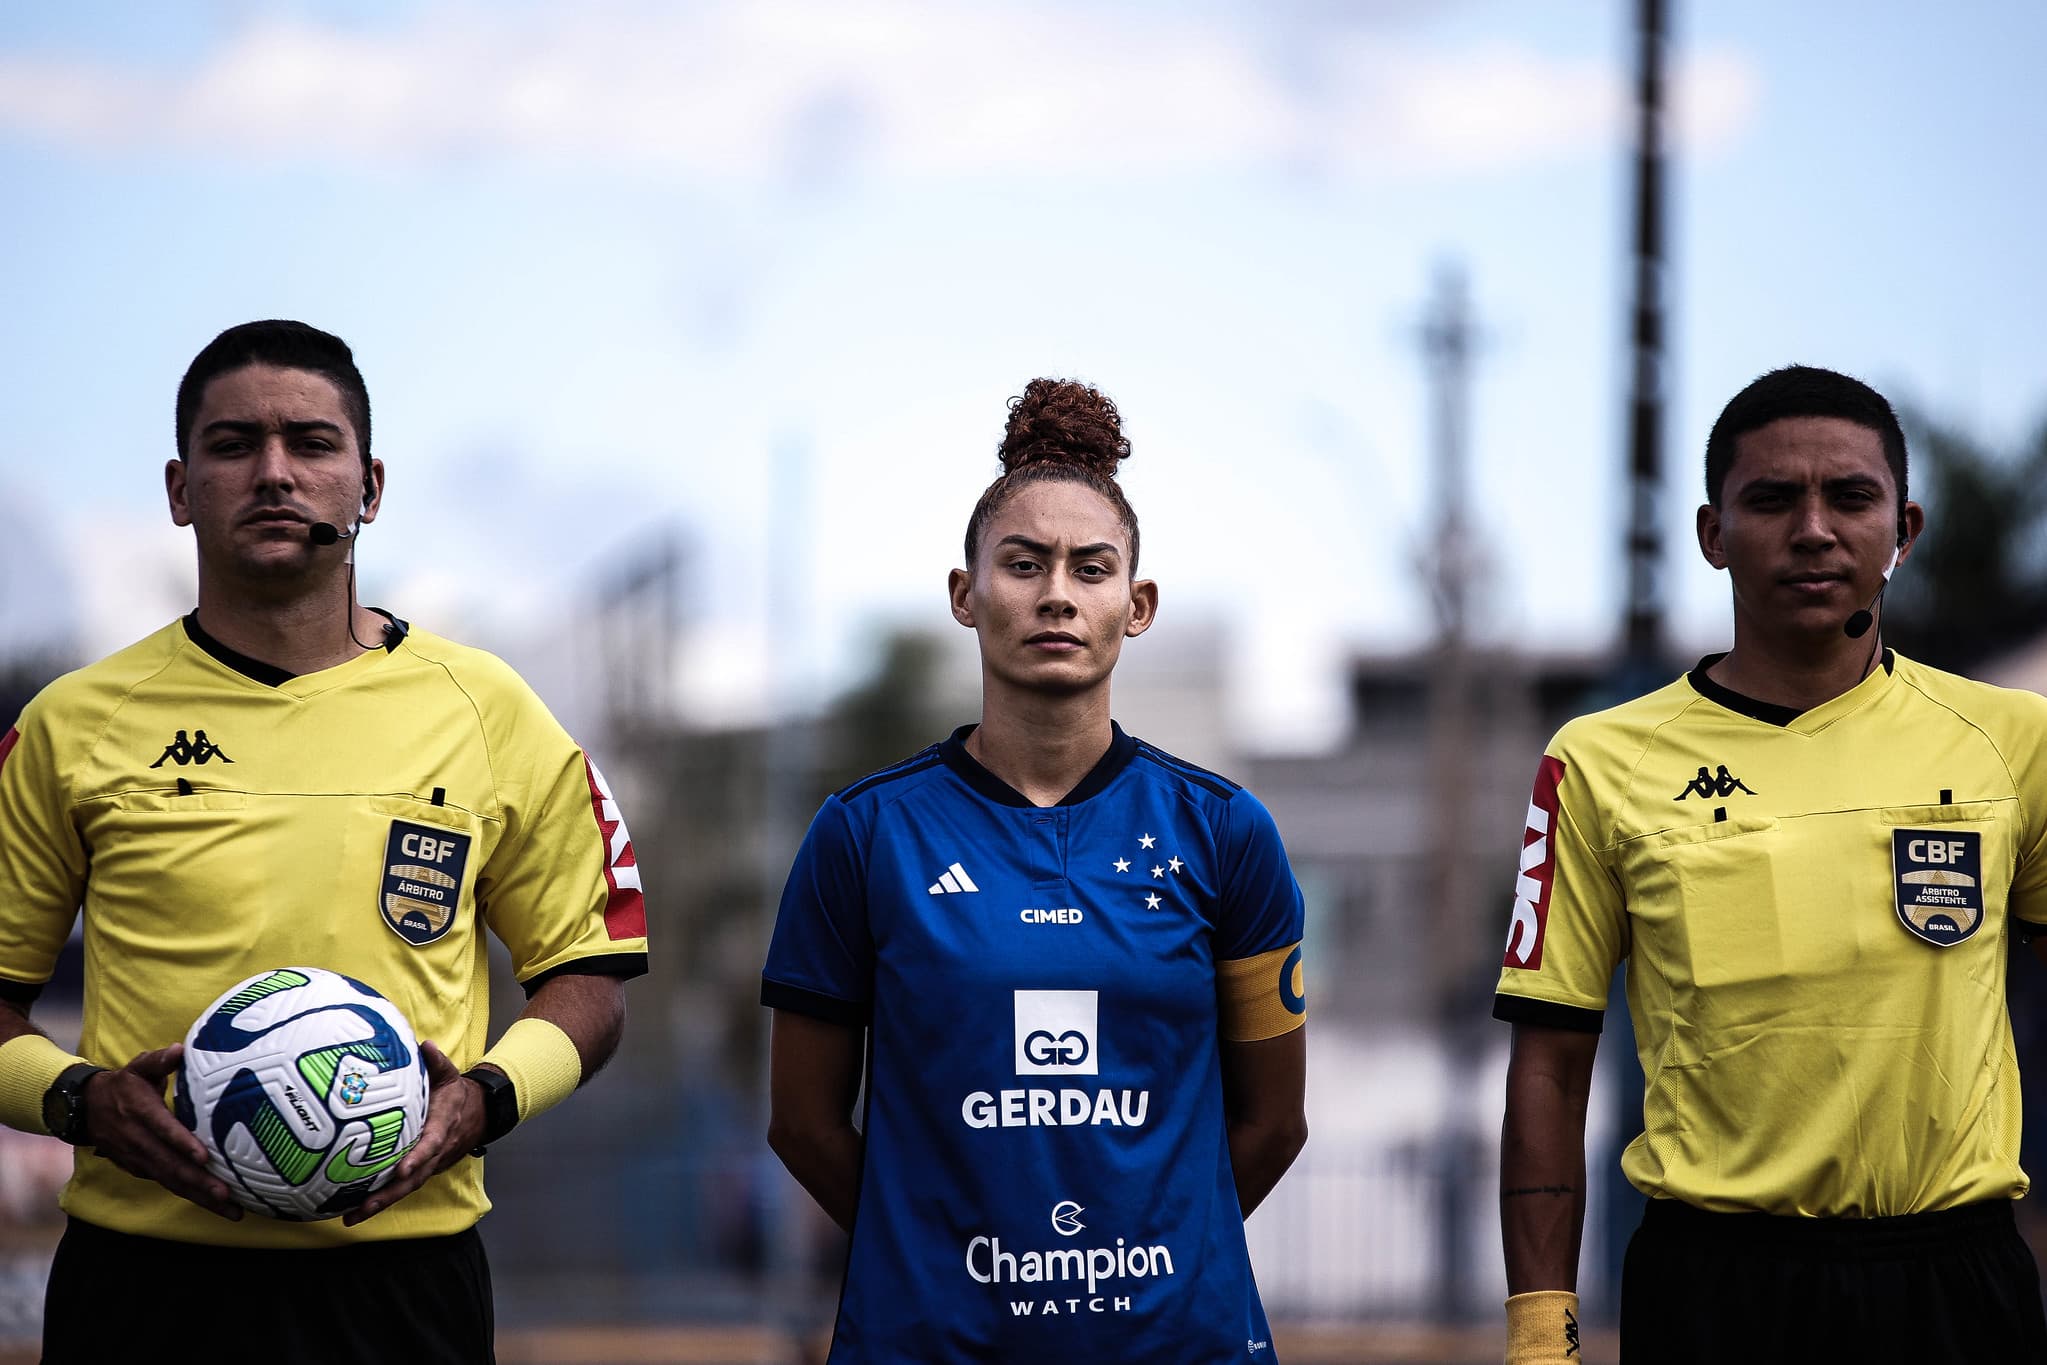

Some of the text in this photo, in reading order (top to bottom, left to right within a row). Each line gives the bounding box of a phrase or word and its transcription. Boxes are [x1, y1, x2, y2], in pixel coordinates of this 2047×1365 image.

[401, 833, 456, 864] CBF
[1908, 839, 1965, 864] CBF
[397, 880, 444, 901] ÁRBITRO
[1915, 895, 1967, 905] ASSISTENTE
[1921, 886, 1960, 897] ÁRBITRO
[403, 919, 428, 931] BRASIL
[1020, 908, 1083, 924] CIMED
[1928, 923, 1955, 931] BRASIL
[961, 1089, 1149, 1129] GERDAU
[966, 1235, 1174, 1294] Champion
[1010, 1296, 1130, 1316] WATCH
